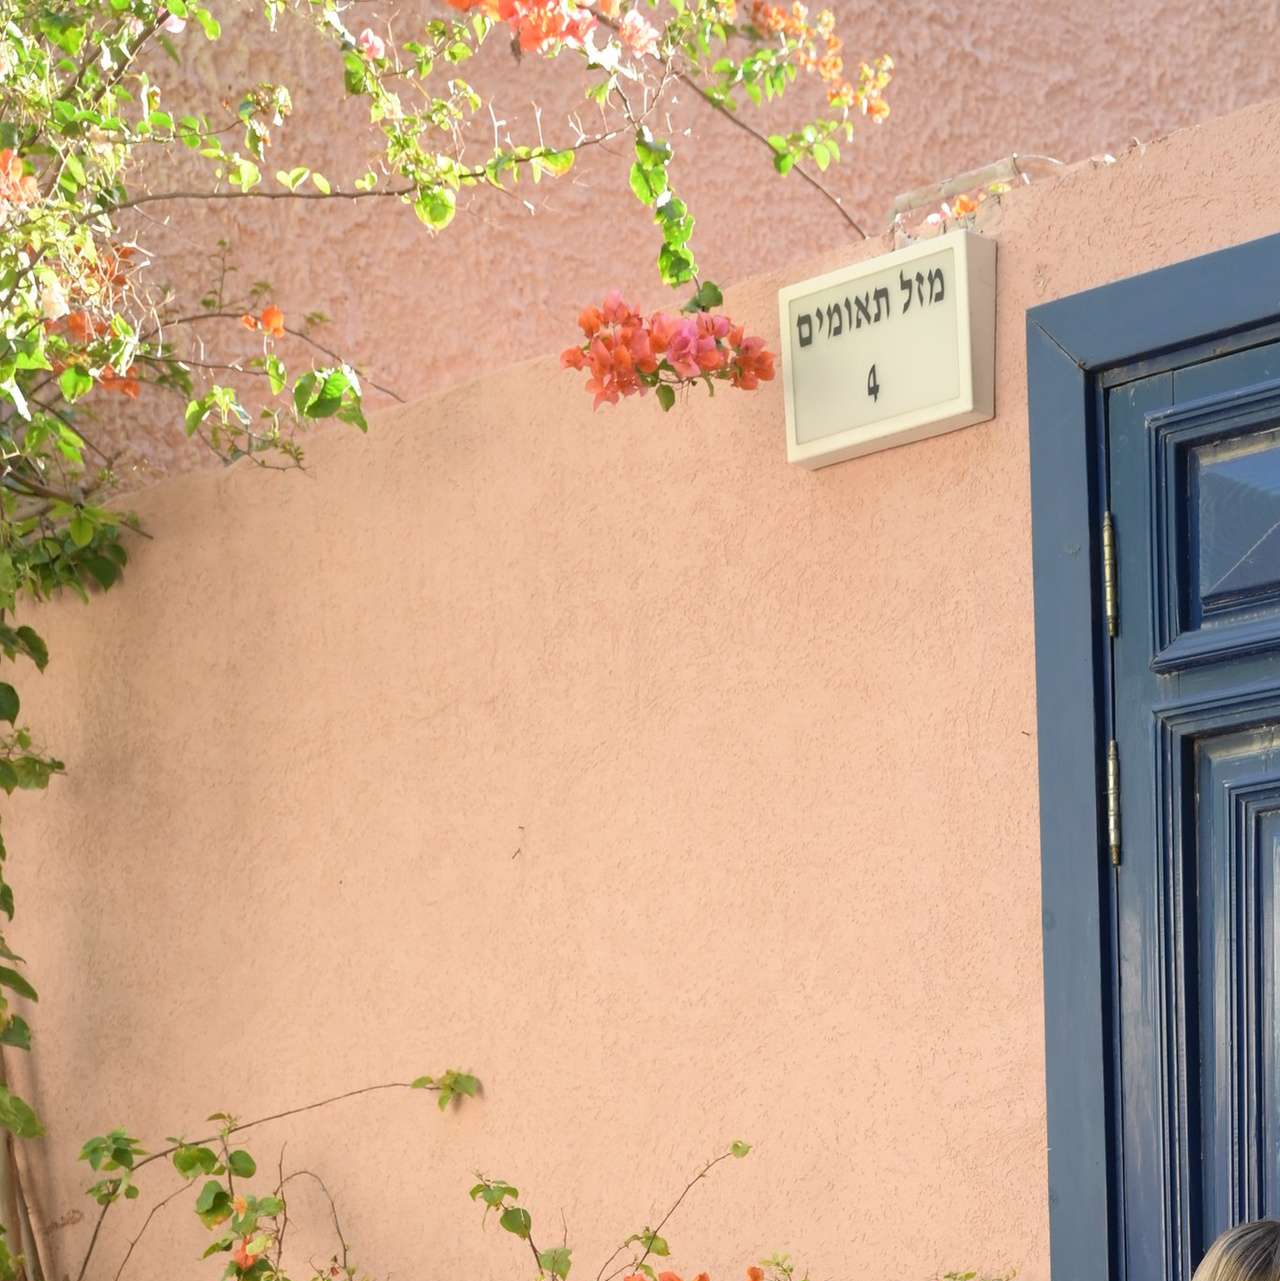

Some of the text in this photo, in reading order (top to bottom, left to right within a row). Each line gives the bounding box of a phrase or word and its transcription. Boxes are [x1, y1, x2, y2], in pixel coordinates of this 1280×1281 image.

[796, 267, 945, 348] מזל תאומים
[867, 363, 880, 403] 4
